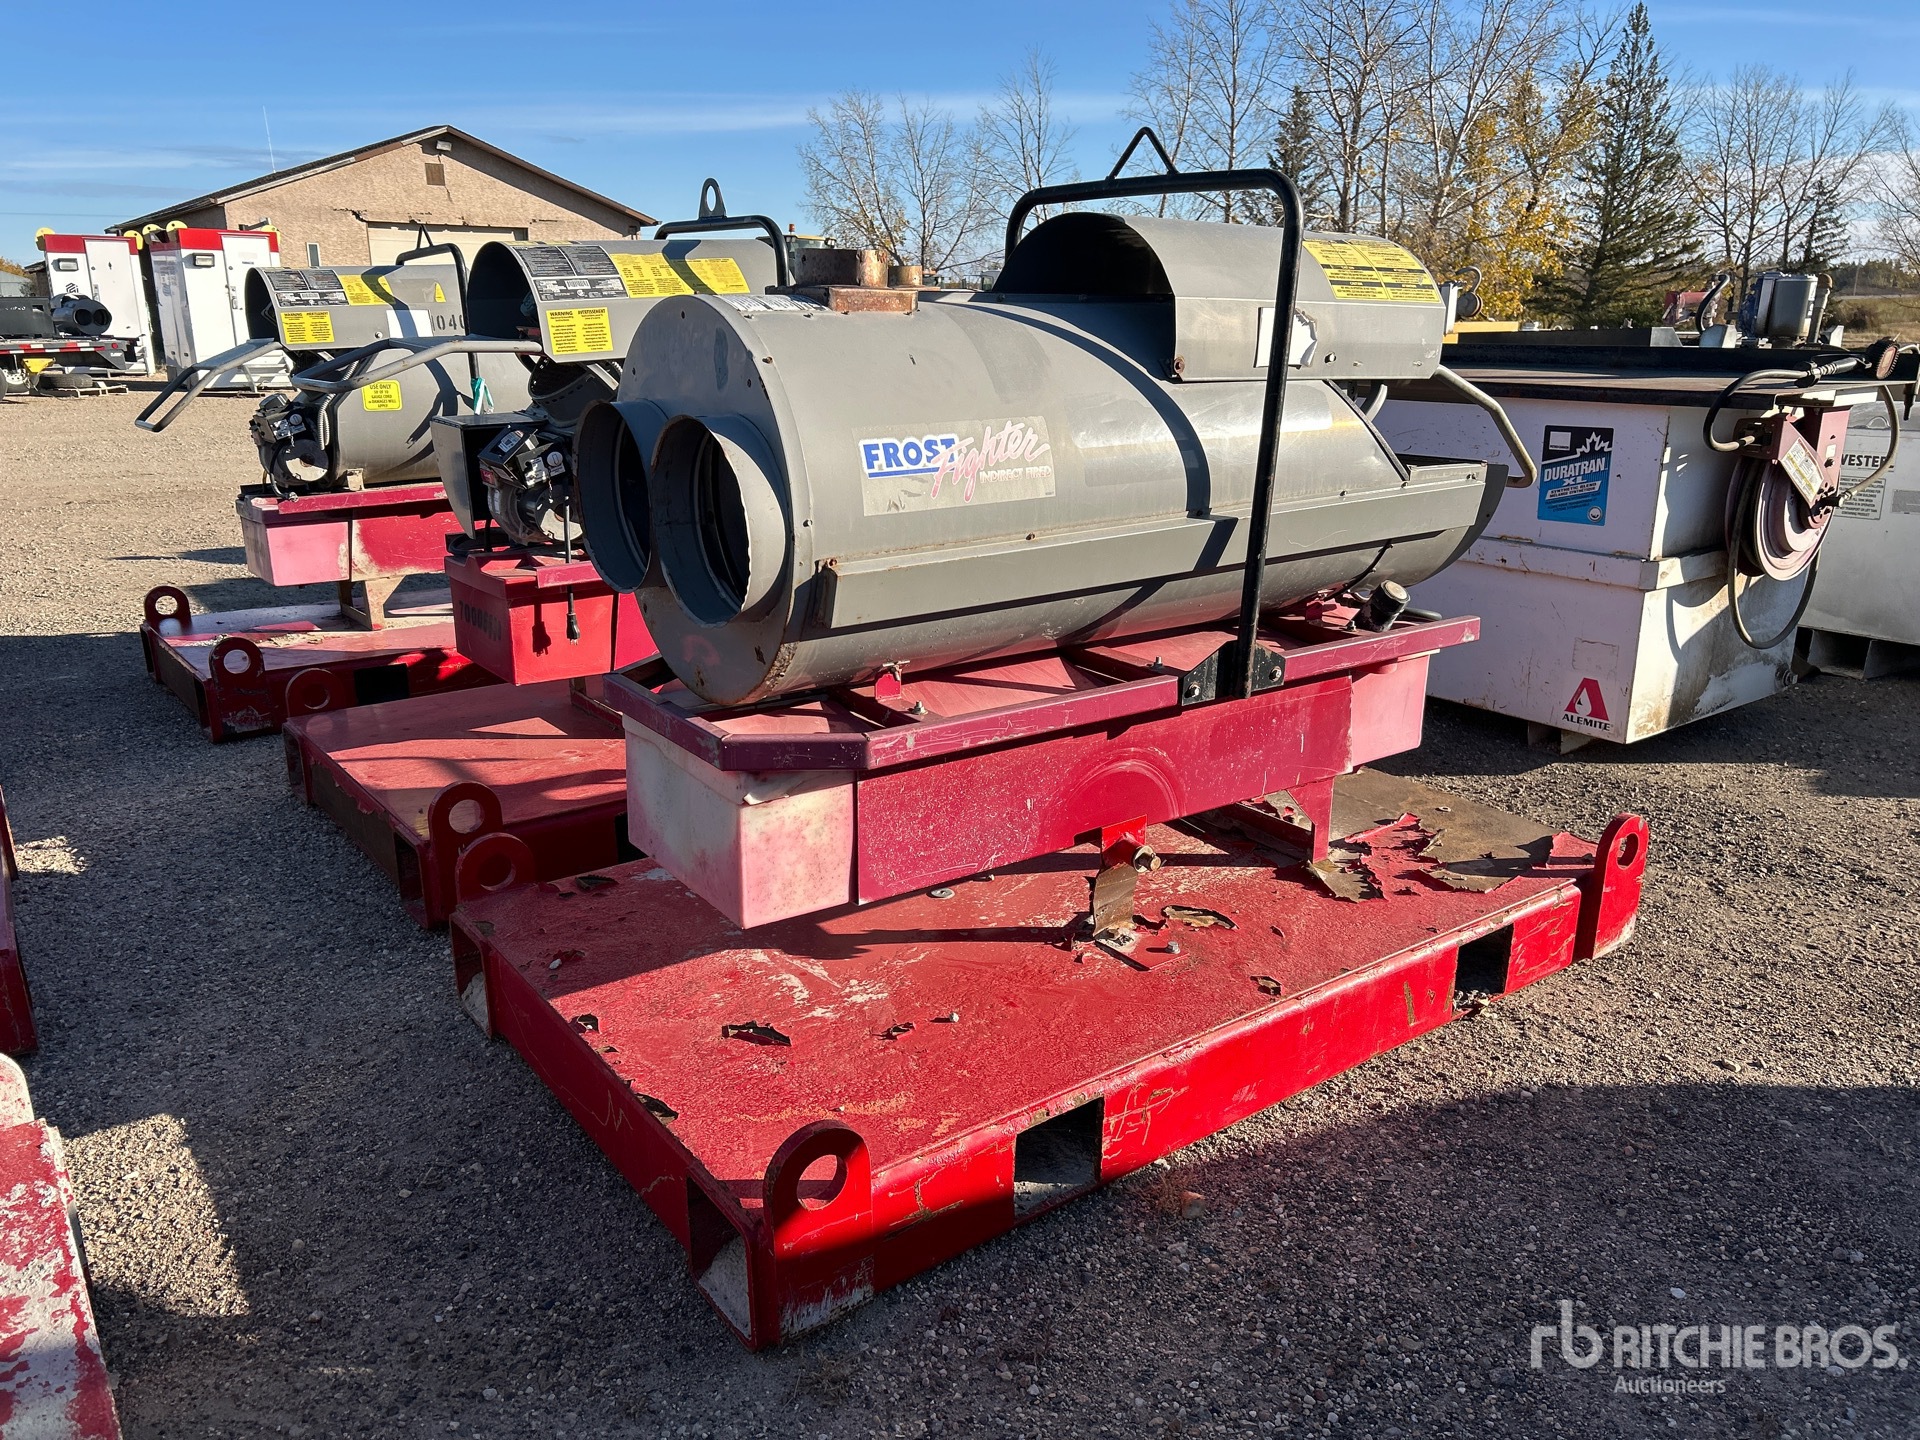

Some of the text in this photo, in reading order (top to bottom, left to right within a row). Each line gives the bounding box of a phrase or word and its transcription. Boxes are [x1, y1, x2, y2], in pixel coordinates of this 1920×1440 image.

[862, 420, 1050, 502] FROST Fighter
[1543, 457, 1606, 482] DURATRAN
[979, 465, 1052, 483] INDIRECT FIRED
[1562, 477, 1588, 487] XL
[1551, 485, 1579, 494] SYNTHETIC
[1562, 713, 1611, 732] ALEMITE
